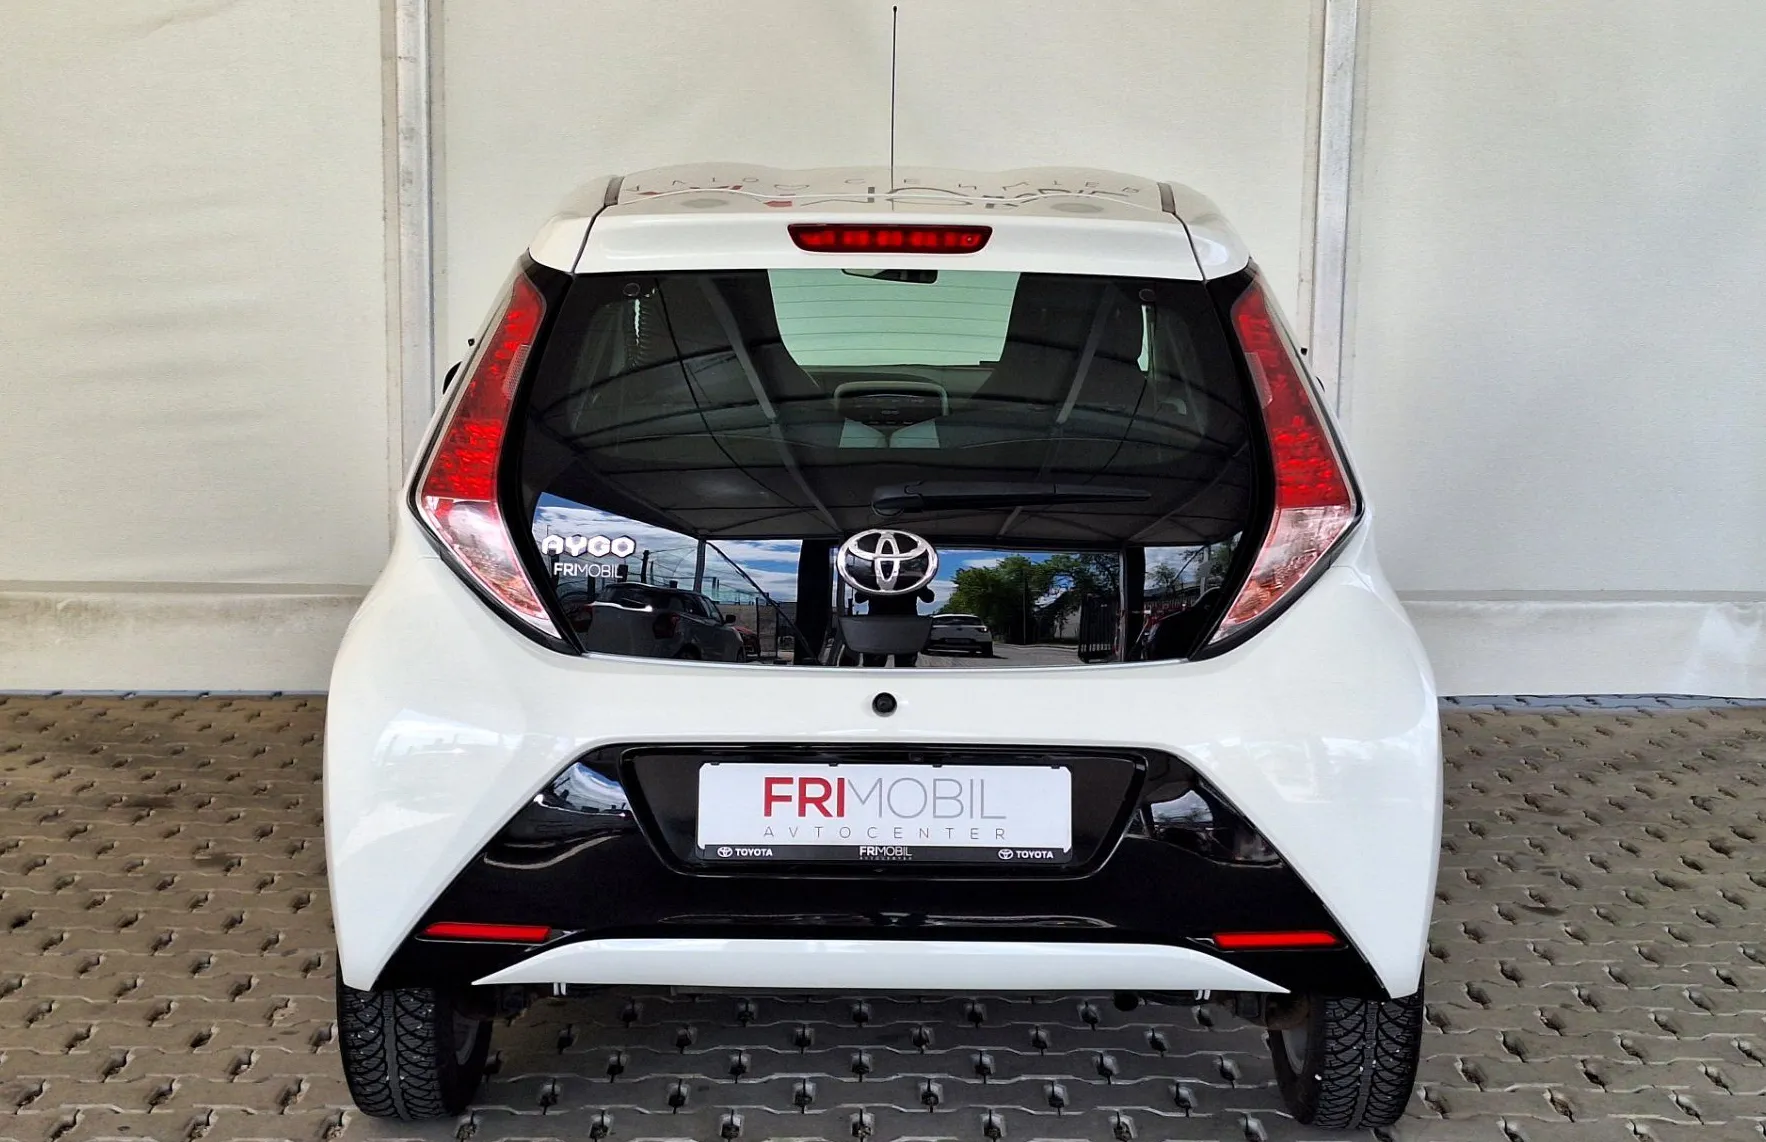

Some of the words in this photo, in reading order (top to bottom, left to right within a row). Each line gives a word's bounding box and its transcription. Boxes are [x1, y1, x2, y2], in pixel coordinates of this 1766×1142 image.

[541, 534, 636, 558] AYGO
[554, 562, 623, 579] FRIMOBIL
[763, 776, 1007, 820] FRIMOBIL
[763, 826, 1006, 840] AVTOCENTER
[735, 848, 773, 857] TOYOTA
[859, 846, 912, 857] FRIMOBIL
[1016, 850, 1054, 859] TOYOTA
